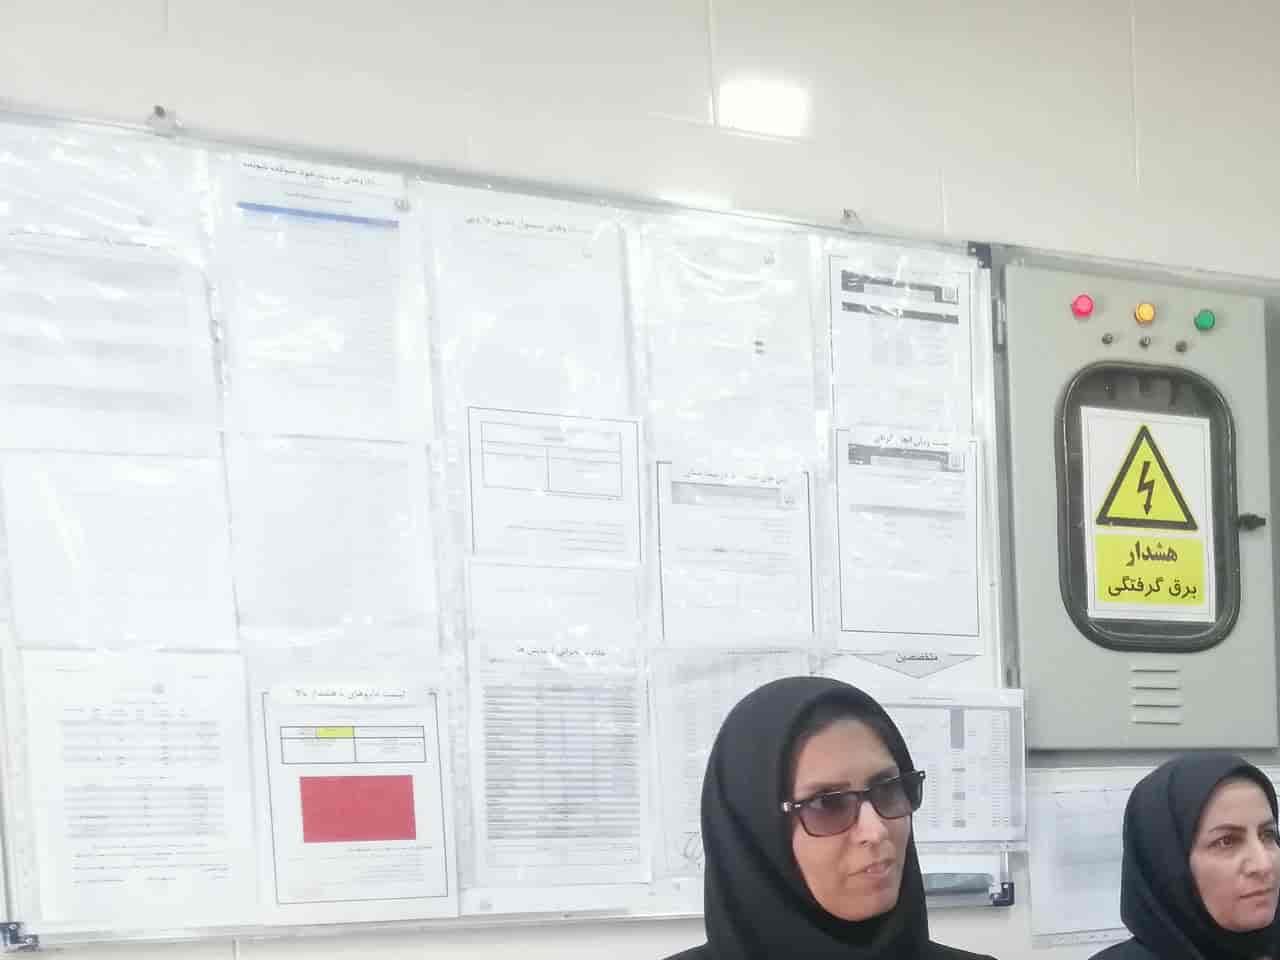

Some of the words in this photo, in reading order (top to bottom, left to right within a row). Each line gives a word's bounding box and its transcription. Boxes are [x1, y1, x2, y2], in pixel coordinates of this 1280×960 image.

[1126, 540, 1178, 567] هشدار
[1108, 576, 1164, 597] گرفتگی
[1168, 579, 1198, 599] برق
